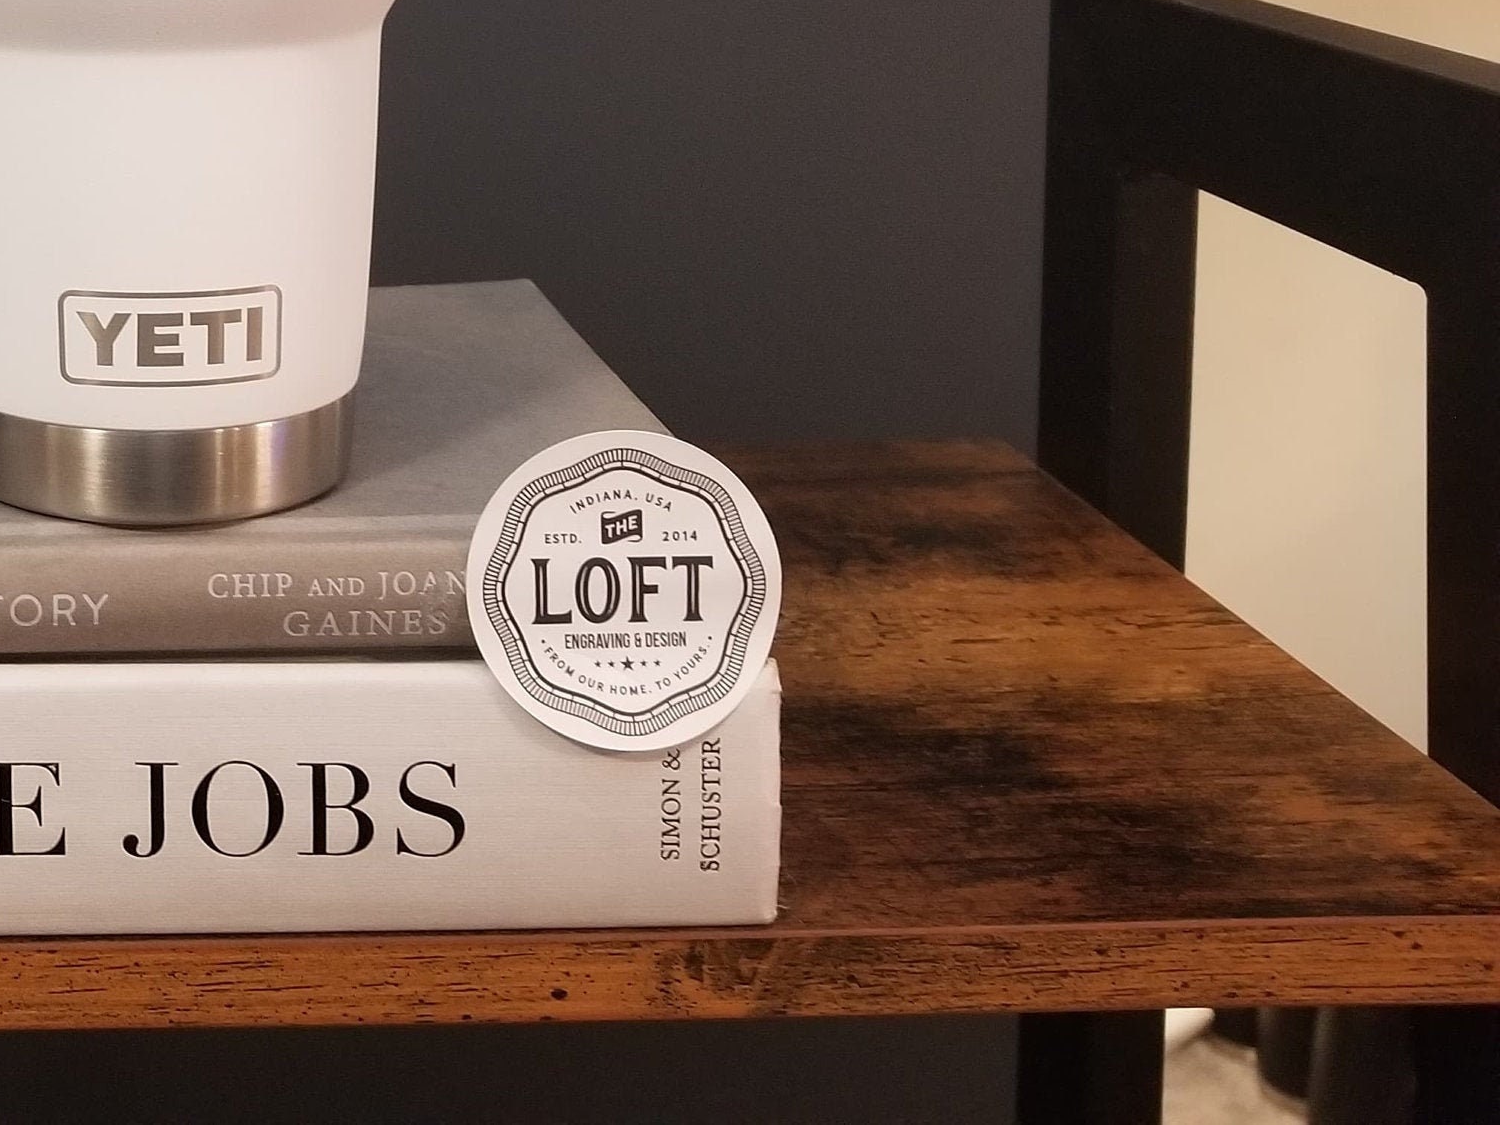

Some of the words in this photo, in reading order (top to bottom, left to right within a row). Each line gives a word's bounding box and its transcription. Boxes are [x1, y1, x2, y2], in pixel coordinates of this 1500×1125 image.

[76, 306, 263, 366] YETI
[645, 492, 672, 512] USA
[544, 533, 582, 544] ESTD.
[662, 531, 698, 542] 2014
[604, 515, 638, 538] THE
[207, 573, 293, 598] CHIP
[307, 577, 364, 597] AND
[531, 556, 713, 625] LOFT
[283, 610, 450, 637] GAINES
[564, 633, 630, 649] ENGRAVING
[634, 633, 642, 648] &
[645, 631, 687, 648] DESIGN
[544, 646, 575, 677] FROM
[578, 674, 604, 692] OUR
[655, 677, 671, 690] TO
[662, 749, 681, 771] &
[122, 760, 467, 858] JOBS
[700, 737, 722, 872] SCHUSTER
[660, 779, 681, 860] SIMON
